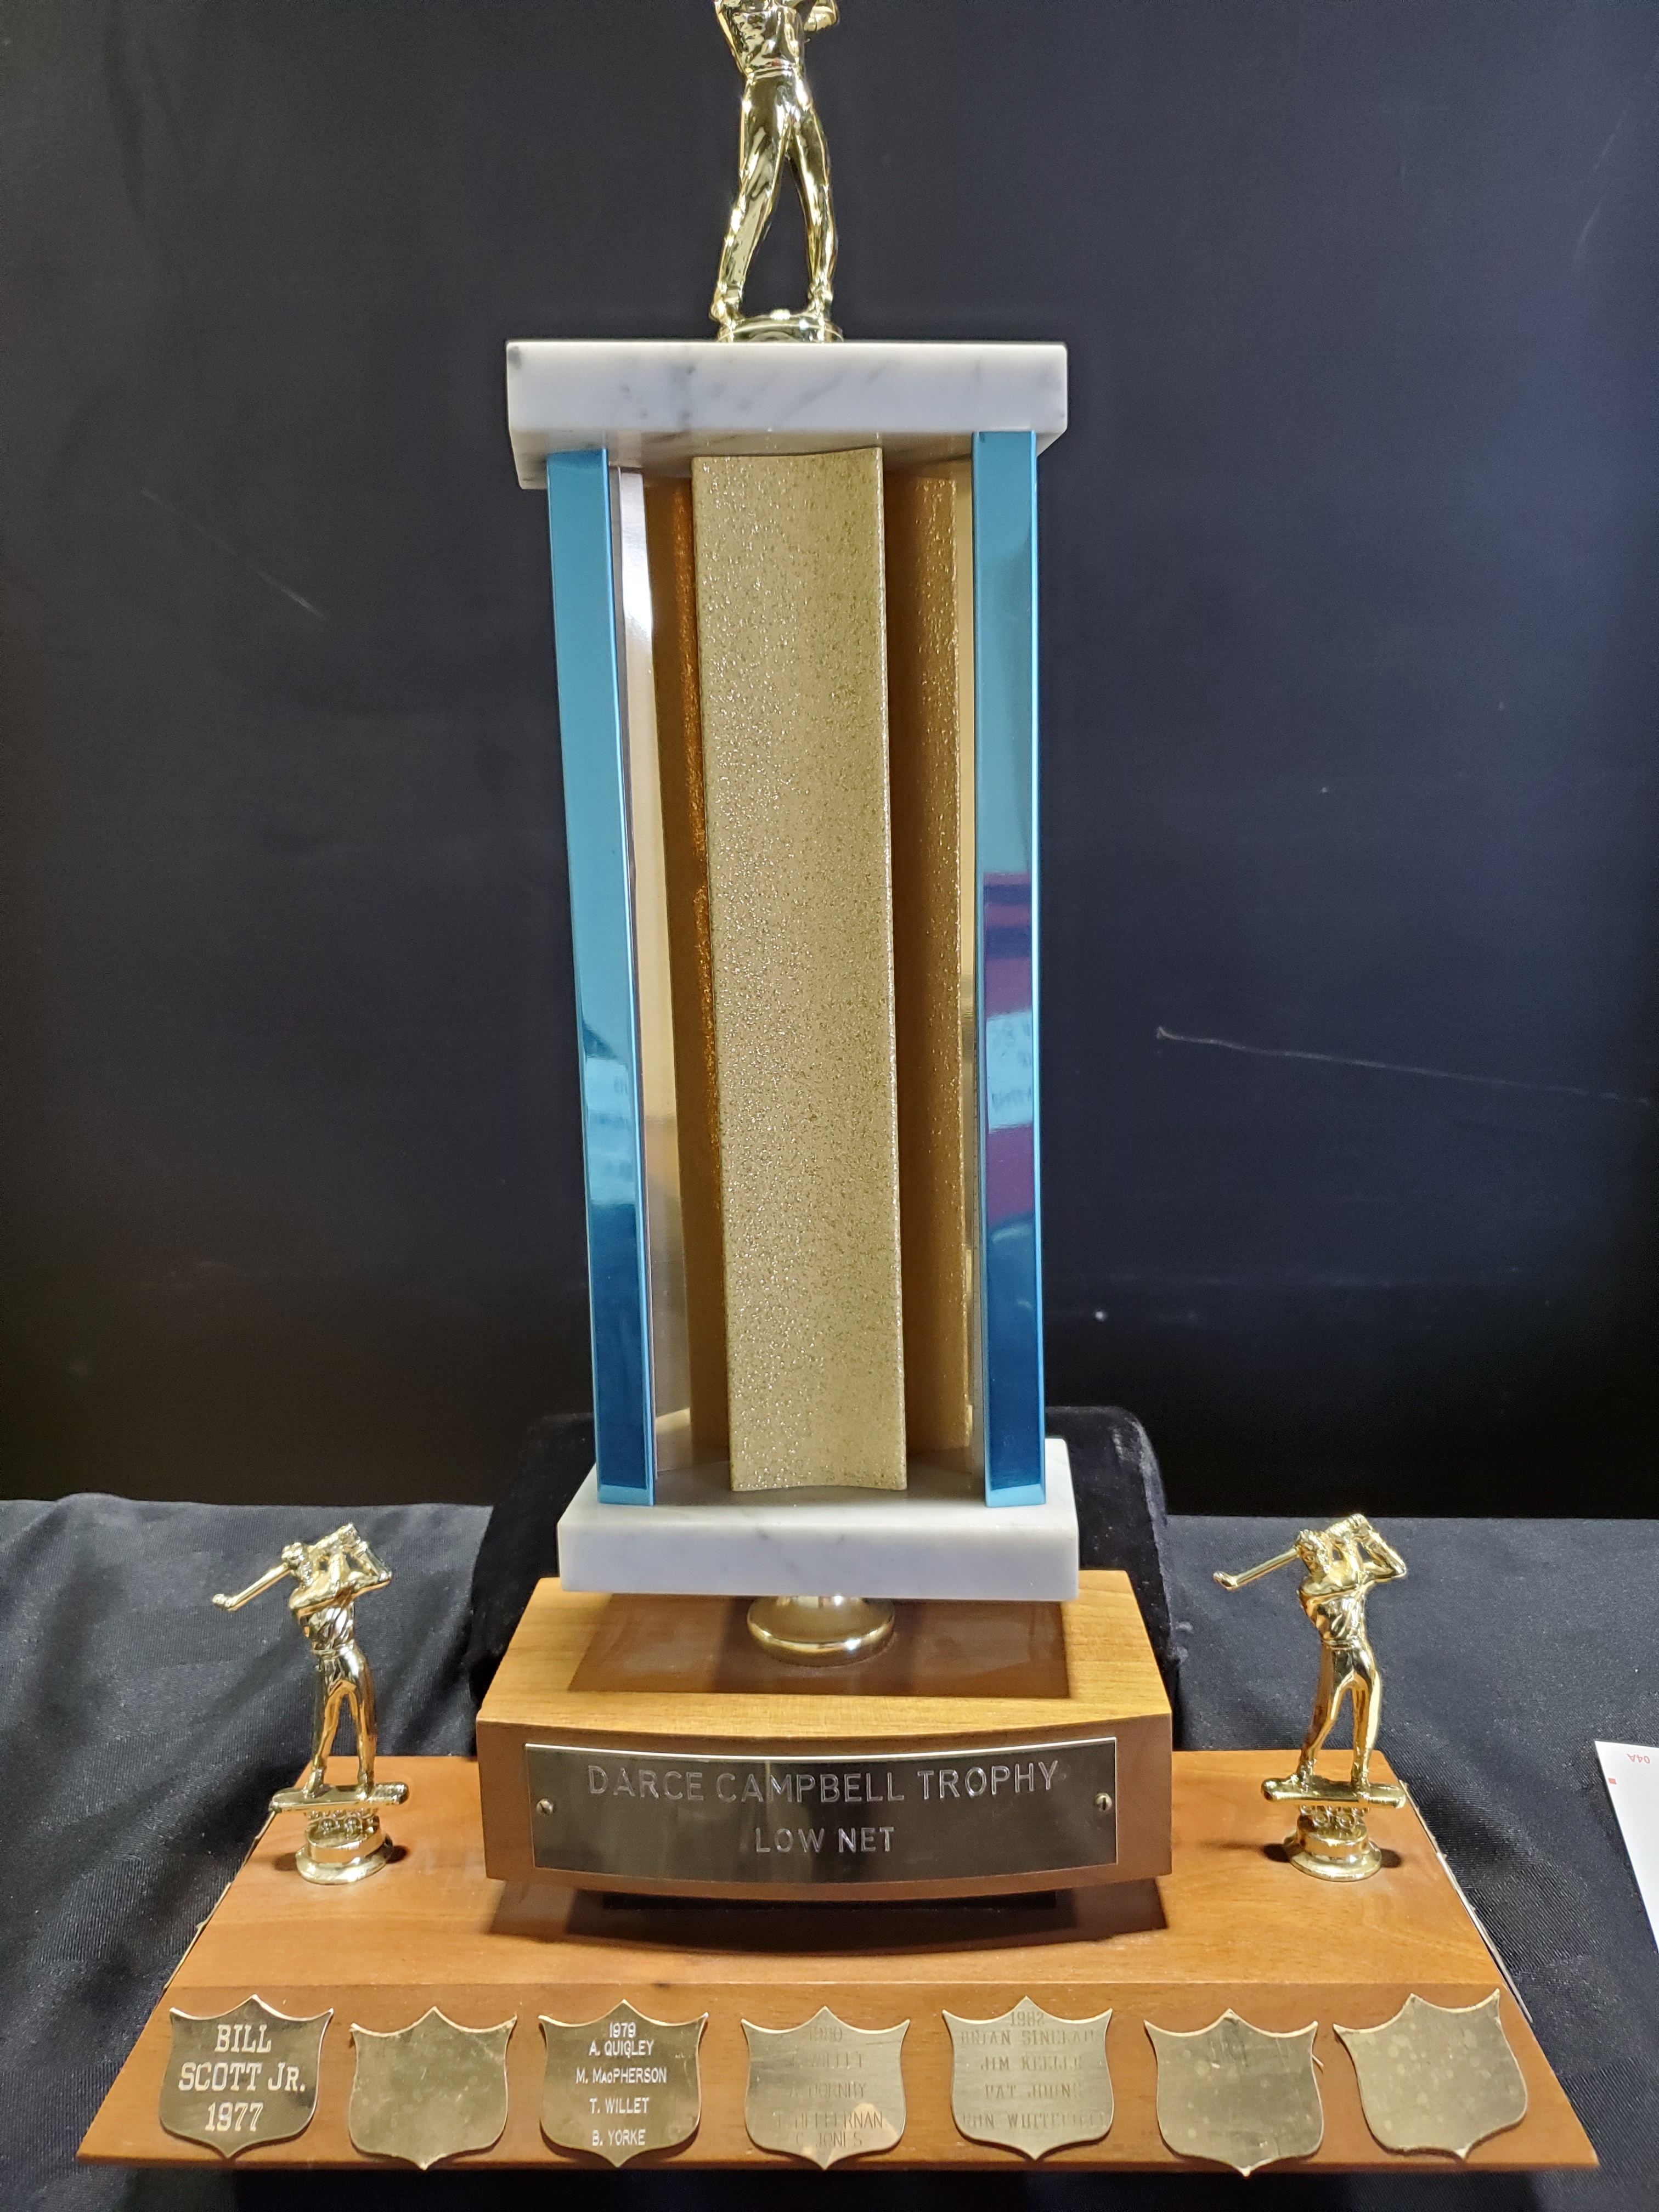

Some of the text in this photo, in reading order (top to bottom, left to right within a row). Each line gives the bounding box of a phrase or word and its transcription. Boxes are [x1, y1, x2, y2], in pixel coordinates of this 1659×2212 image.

[588, 1760, 1058, 1803] DARCE CAMPBELL TROPHY
[755, 1826, 894, 1853] LOW NET
[1010, 2011, 1045, 2027] 1982
[214, 2023, 272, 2053] BILL
[609, 2022, 636, 2038] 1979
[809, 2027, 843, 2042] 1980
[961, 2029, 1011, 2046] BRIAN
[589, 2039, 654, 2058] A. QUIGLEY
[980, 2056, 1010, 2070] JIM
[178, 2061, 263, 2091] SCOTT
[575, 2067, 589, 2084] M.
[985, 2083, 1016, 2098] PAT
[589, 2097, 650, 2114] T. WILLET
[205, 2102, 264, 2132] 1977
[592, 2129, 646, 2146] B. YORKE
